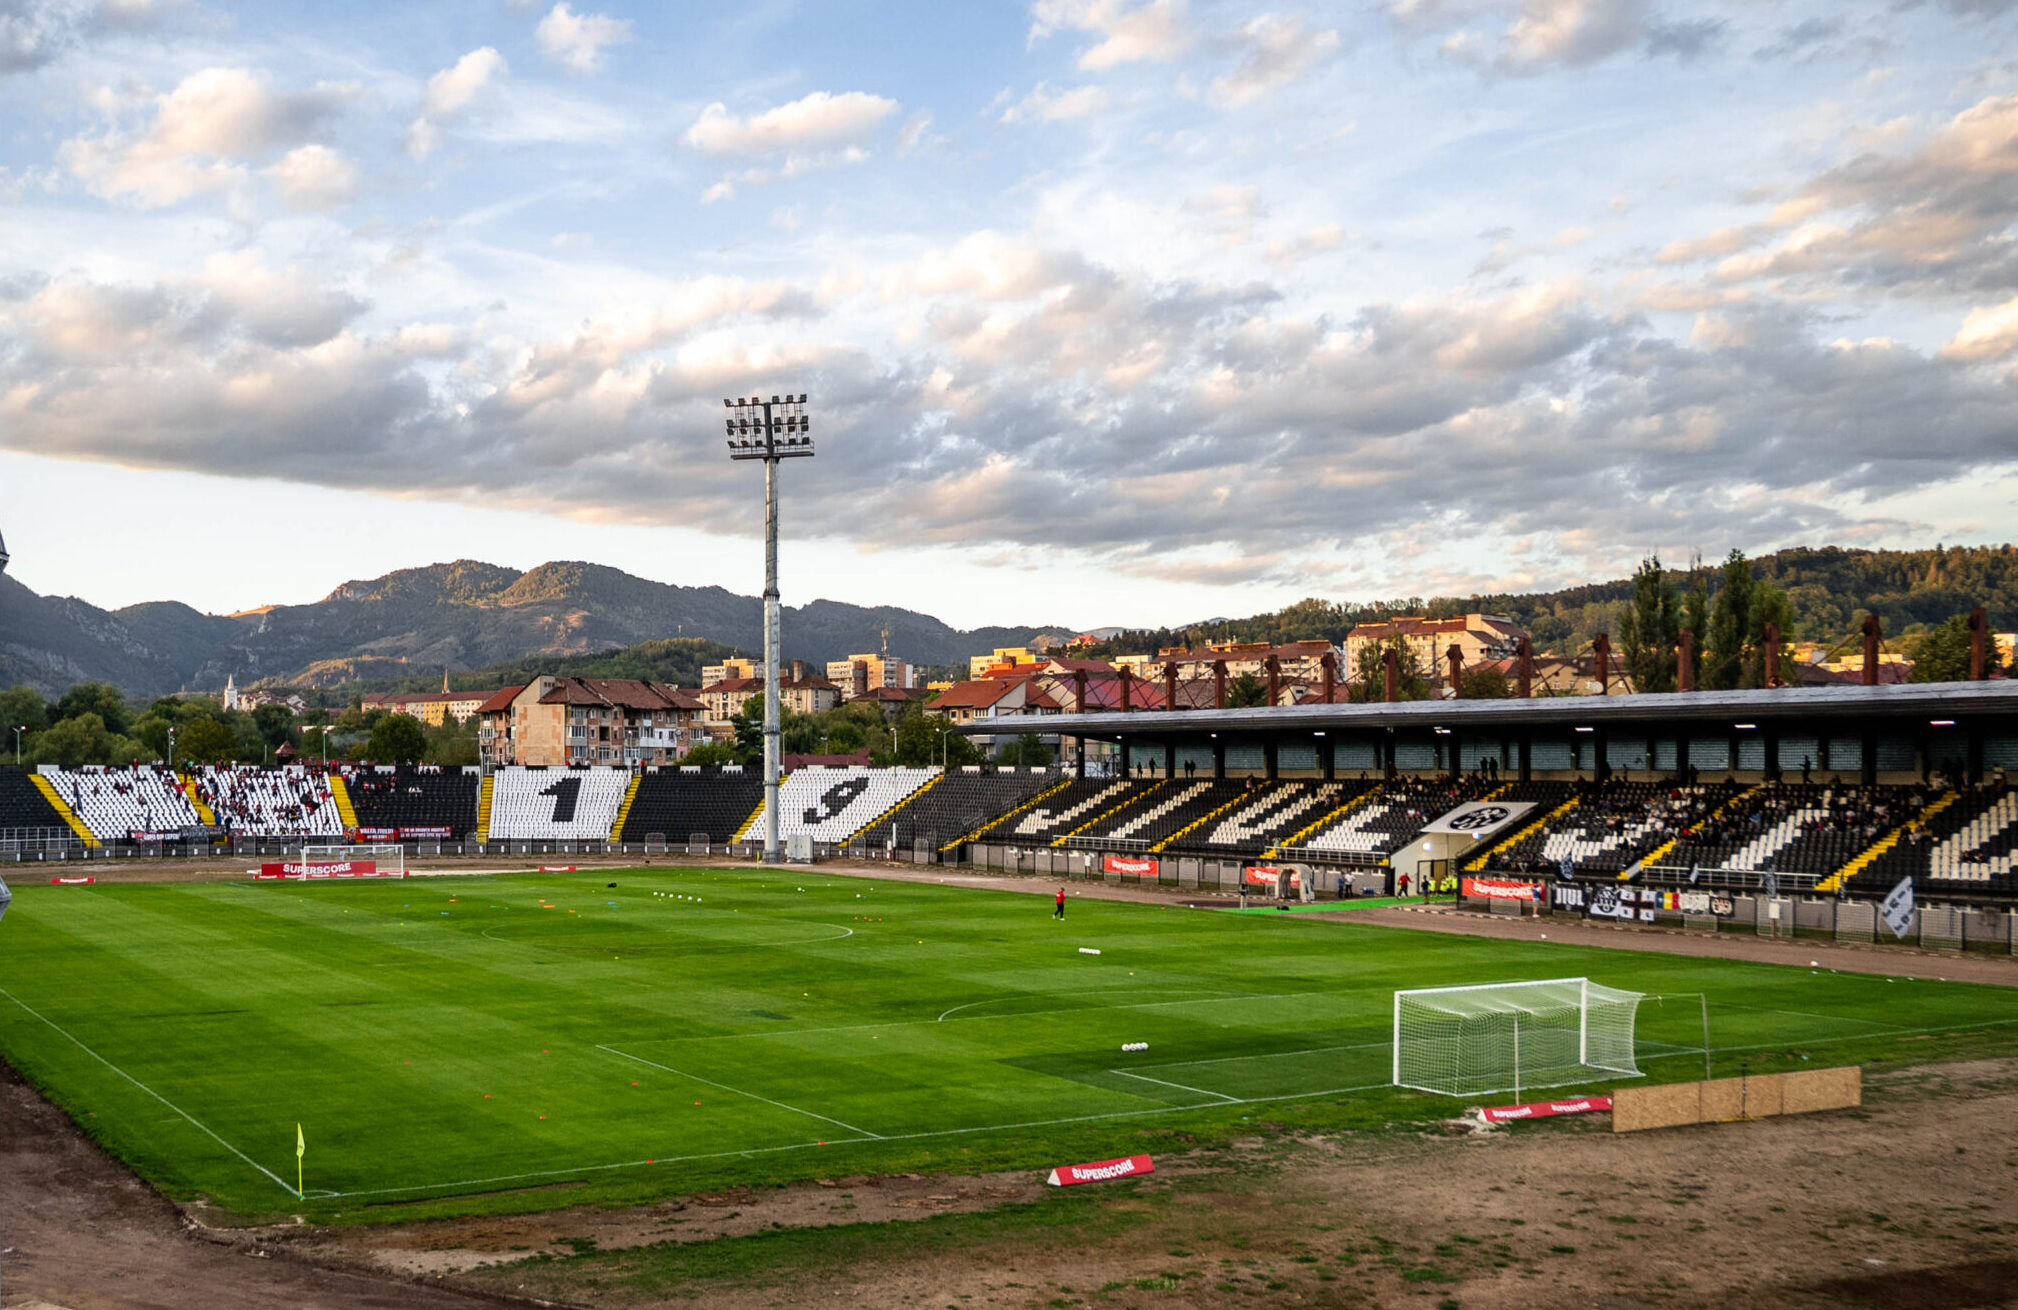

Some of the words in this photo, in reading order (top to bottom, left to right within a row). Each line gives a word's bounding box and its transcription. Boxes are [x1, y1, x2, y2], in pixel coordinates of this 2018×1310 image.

[538, 777, 582, 823] 1
[802, 776, 870, 824] 9
[283, 862, 352, 875] SUPERSCORE
[1473, 882, 1533, 897] SUPERSCORE
[1555, 888, 1585, 906] JIUL
[1492, 1107, 1532, 1118] SUPERSCORE
[1071, 1159, 1135, 1180] SUPERSCORE
